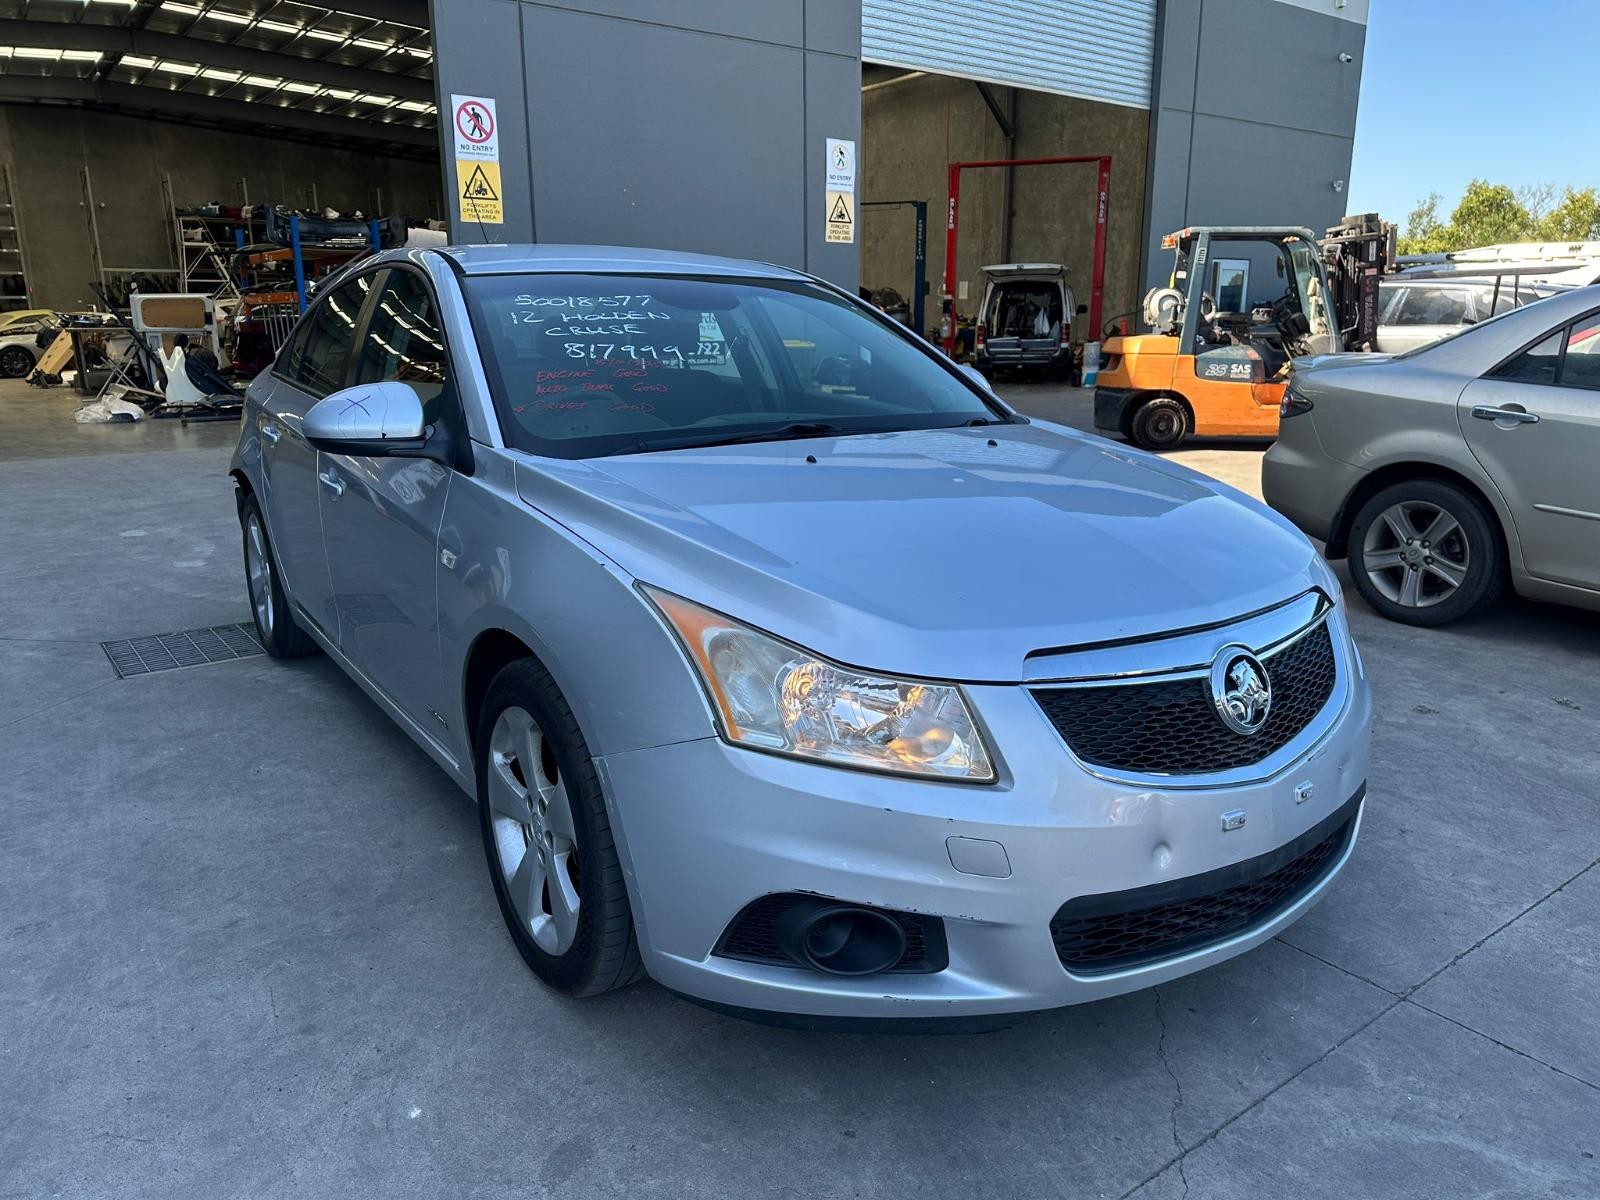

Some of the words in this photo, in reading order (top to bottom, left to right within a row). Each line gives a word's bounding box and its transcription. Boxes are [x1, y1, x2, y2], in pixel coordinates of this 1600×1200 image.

[514, 294, 652, 308] 50018577
[561, 310, 672, 324] HOLDEN
[1364, 293, 1374, 335] TOYOTA
[536, 369, 596, 383] ENGINE
[613, 368, 649, 378] GOOD
[1205, 363, 1229, 377] 25
[1230, 363, 1251, 373] SAS
[631, 382, 669, 393] GOOD
